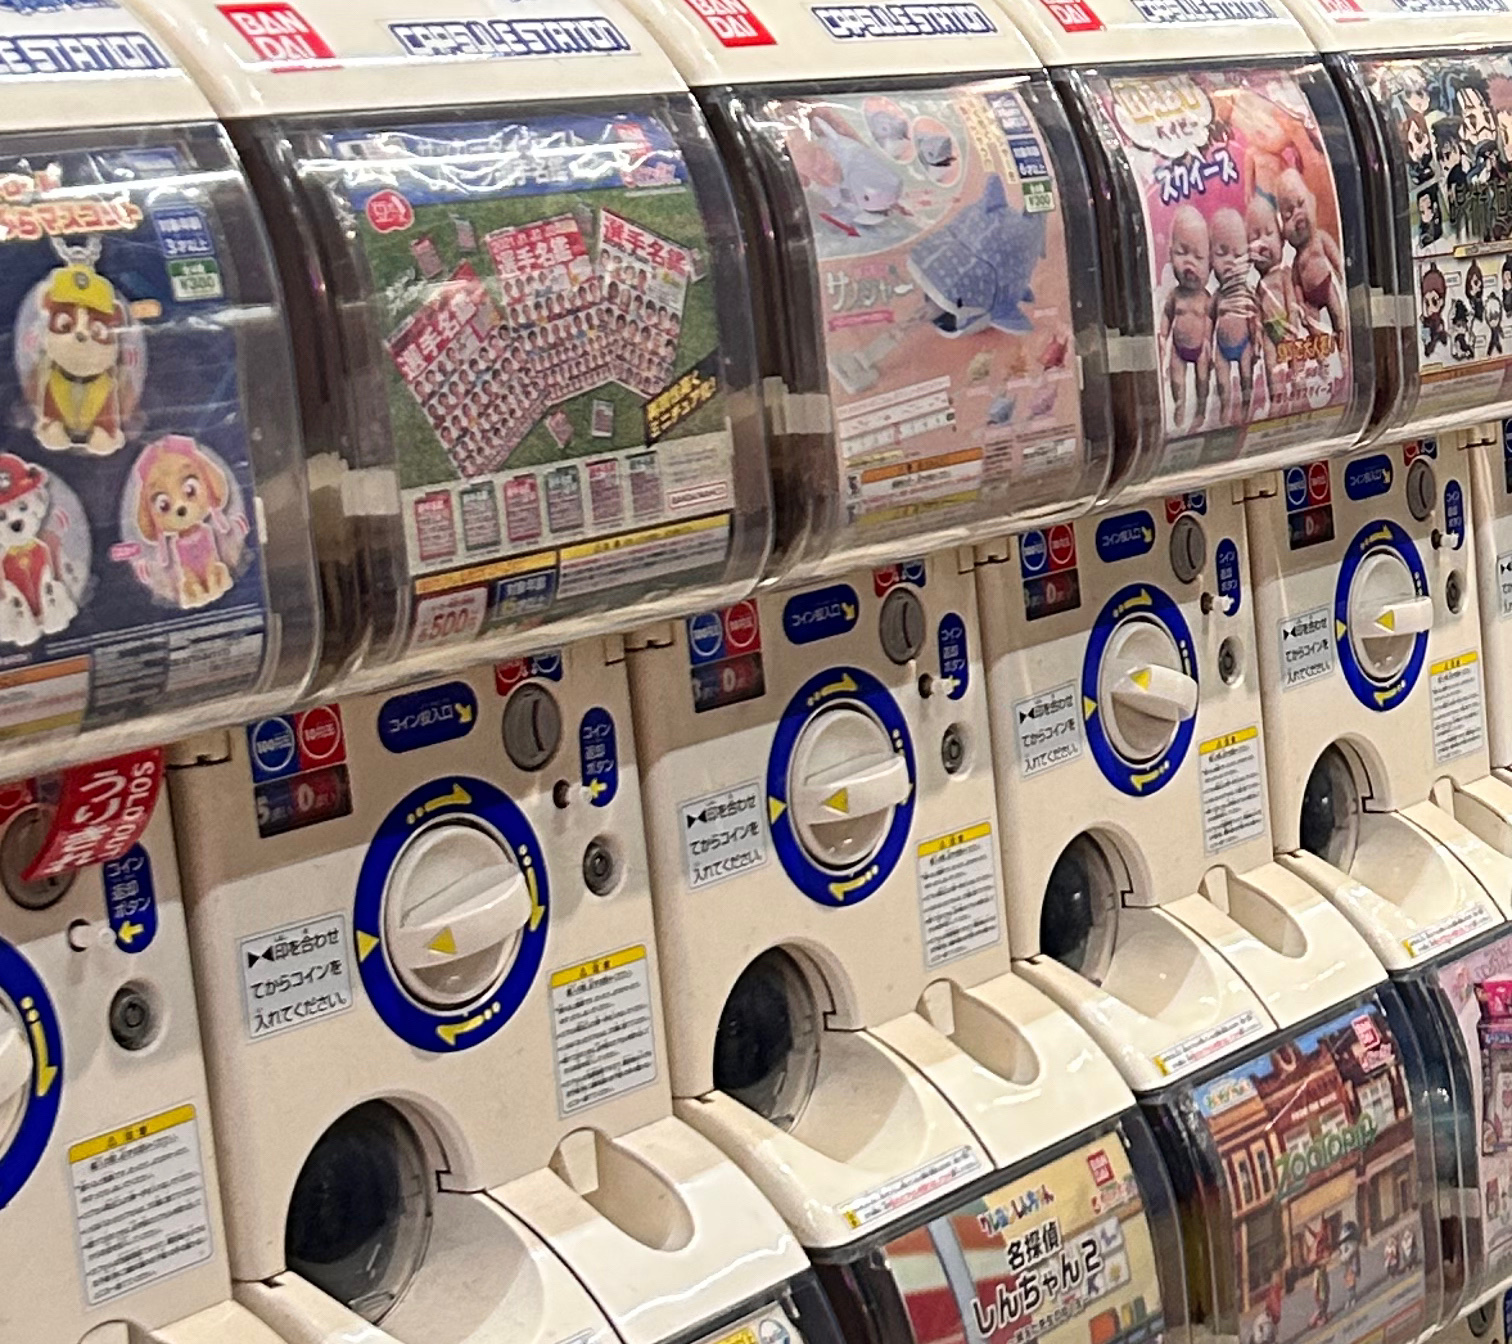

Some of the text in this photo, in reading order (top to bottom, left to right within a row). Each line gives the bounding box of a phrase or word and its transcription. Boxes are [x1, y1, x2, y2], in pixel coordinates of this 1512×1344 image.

[230, 9, 305, 36] BAN
[703, 14, 754, 38] DAI
[1047, 4, 1096, 28] DAI
[253, 35, 316, 61] DAI
[1156, 149, 1239, 204] スクイーズ
[601, 213, 690, 273] 選手名鑑
[120, 760, 155, 821] SOLD
[689, 820, 760, 856] てからコインを
[694, 849, 763, 884] 入れてください
[275, 928, 340, 964] 印を合わせ
[250, 961, 343, 998] てからコインを
[254, 993, 347, 1033] 入れてください
[1006, 1218, 1058, 1272] 名探偵
[973, 1239, 1101, 1336] しんちゃん2
